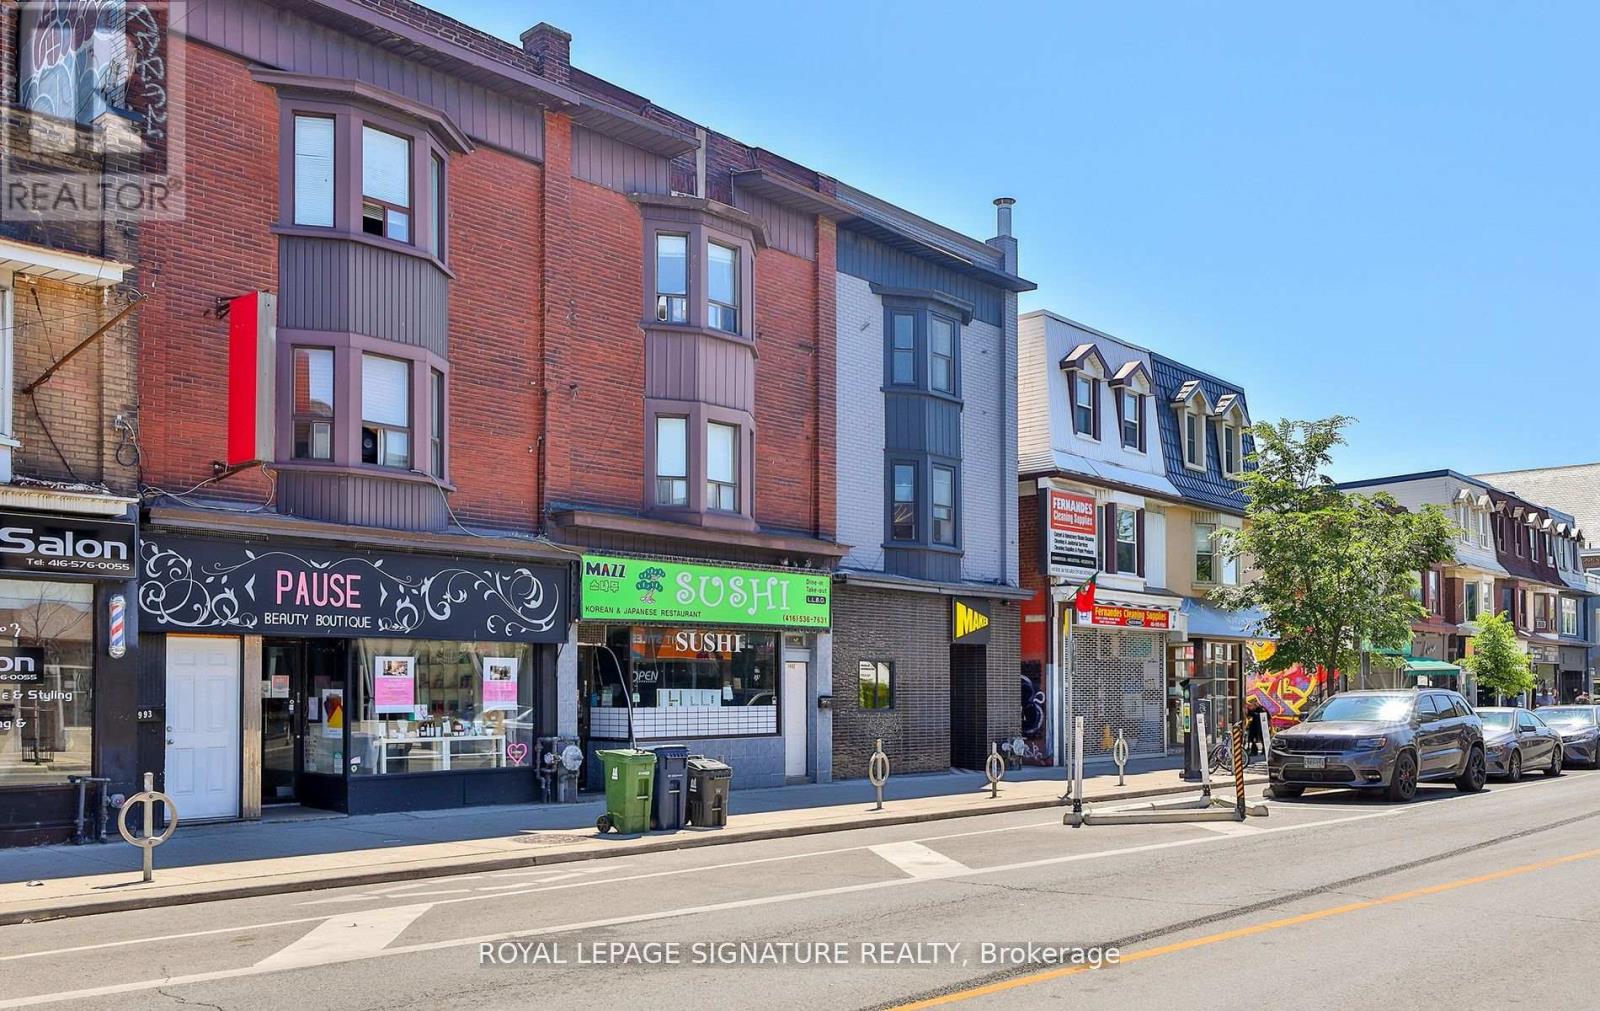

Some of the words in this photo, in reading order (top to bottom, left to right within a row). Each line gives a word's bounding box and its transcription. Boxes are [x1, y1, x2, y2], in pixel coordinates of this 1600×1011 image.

[1053, 497, 1093, 515] FERNANDES
[0, 527, 127, 560] Salon
[48, 559, 130, 571] 416-576-0055
[586, 561, 626, 578] MAZZ
[276, 569, 362, 609] PAUSE
[676, 571, 789, 616] SUSHI
[585, 604, 614, 615] KOREAN
[624, 608, 657, 617] JAPANESE
[661, 609, 702, 618] RESTAURANT
[264, 612, 309, 627] BEAUTY
[316, 613, 372, 629] BOUTIQUE
[676, 631, 742, 653] SUSHI
[28, 690, 73, 702] Styling
[137, 710, 153, 719] 993
